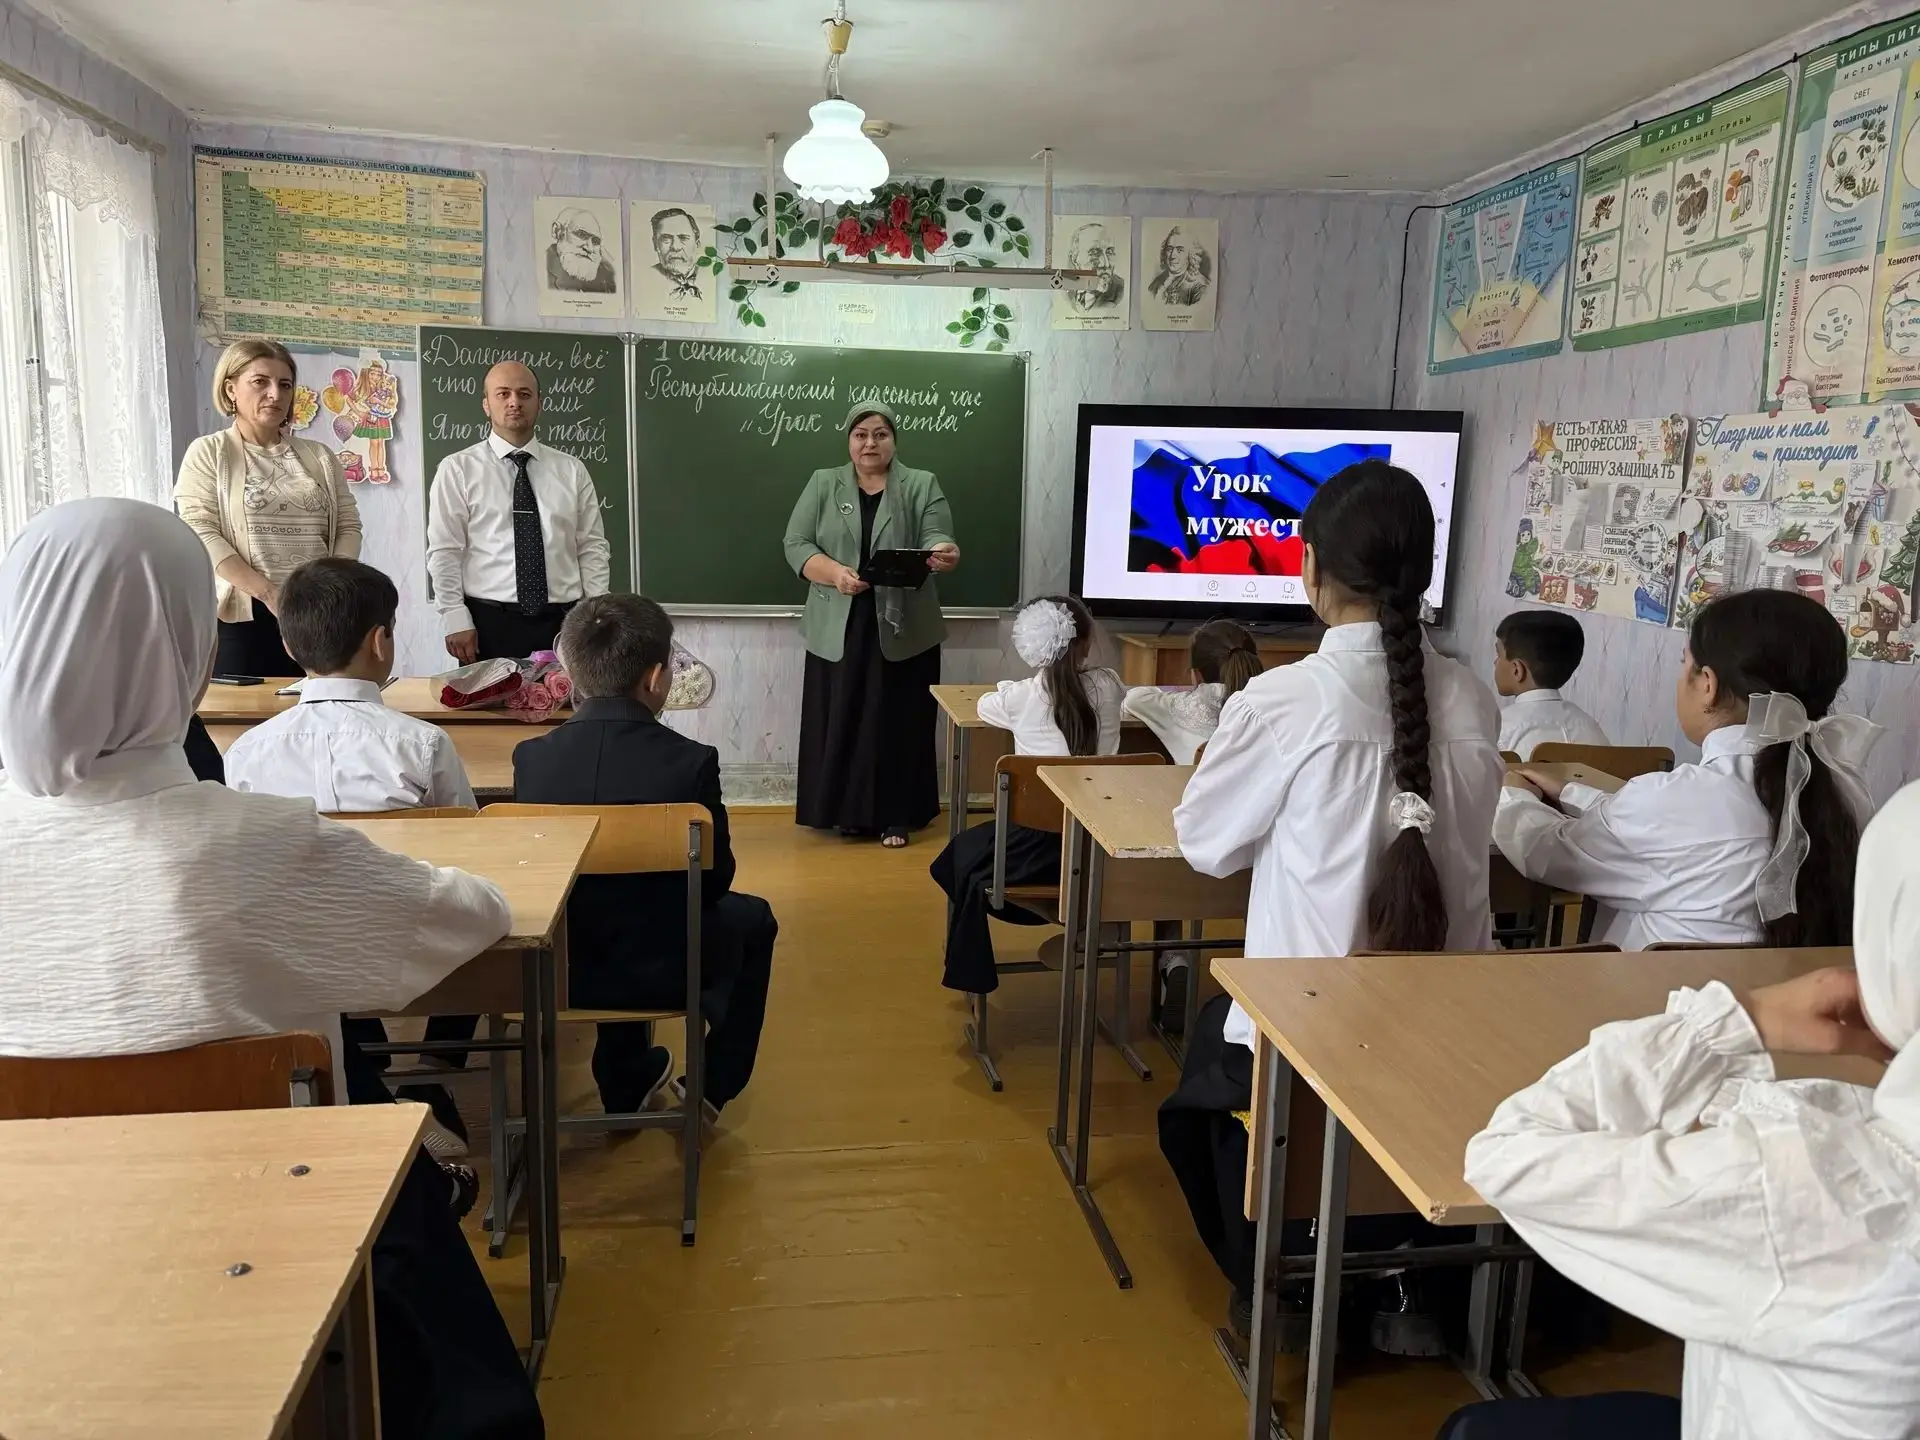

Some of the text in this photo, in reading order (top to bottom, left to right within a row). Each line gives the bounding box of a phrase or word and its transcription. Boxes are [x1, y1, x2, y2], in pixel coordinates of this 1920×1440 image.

[1840, 40, 1880, 64] ТИПЫ
[1843, 49, 1909, 80] ИСТОЧНИК
[1853, 87, 1872, 100] СВЕТ
[1646, 112, 1705, 142] ГРИБЫ
[1832, 104, 1889, 128] Фотоавтотрофы
[1660, 129, 1715, 154] НАСТОЯЩИЕ
[1719, 115, 1752, 133] ГРИБЫ
[194, 145, 265, 160] ПЕРИОДИЧЕСКАЯ
[265, 153, 304, 162] СИСТЕМА
[305, 156, 360, 168] ХИМИЧЕСКИХ
[362, 161, 410, 172] ЭЛЕМЕНТОВ
[1528, 172, 1555, 190] ДРЕВО
[1773, 182, 1798, 348] ИСТОЧНИК УГЛЕРОДА
[1809, 264, 1870, 282] Фотогетеротрофы
[1789, 278, 1801, 332] СОЕДИНЕНИЯ
[571, 341, 609, 369] всё
[655, 340, 796, 381] 1 сентября
[432, 376, 596, 395] что мне
[644, 364, 983, 414] Республиканский классный час
[542, 396, 584, 413] али
[429, 413, 448, 441] Я
[450, 423, 472, 440] по
[548, 416, 606, 442] тобой
[1556, 419, 1628, 436] ЕСТЬ ТАКАЯ
[1695, 414, 1830, 452] Праздник к нам
[1562, 460, 1676, 480] РОДИНУ ЗАЩИЩАТЬ
[1772, 444, 1859, 472] приходит
[1189, 465, 1272, 500] Урок
[1186, 516, 1302, 543] мужест
